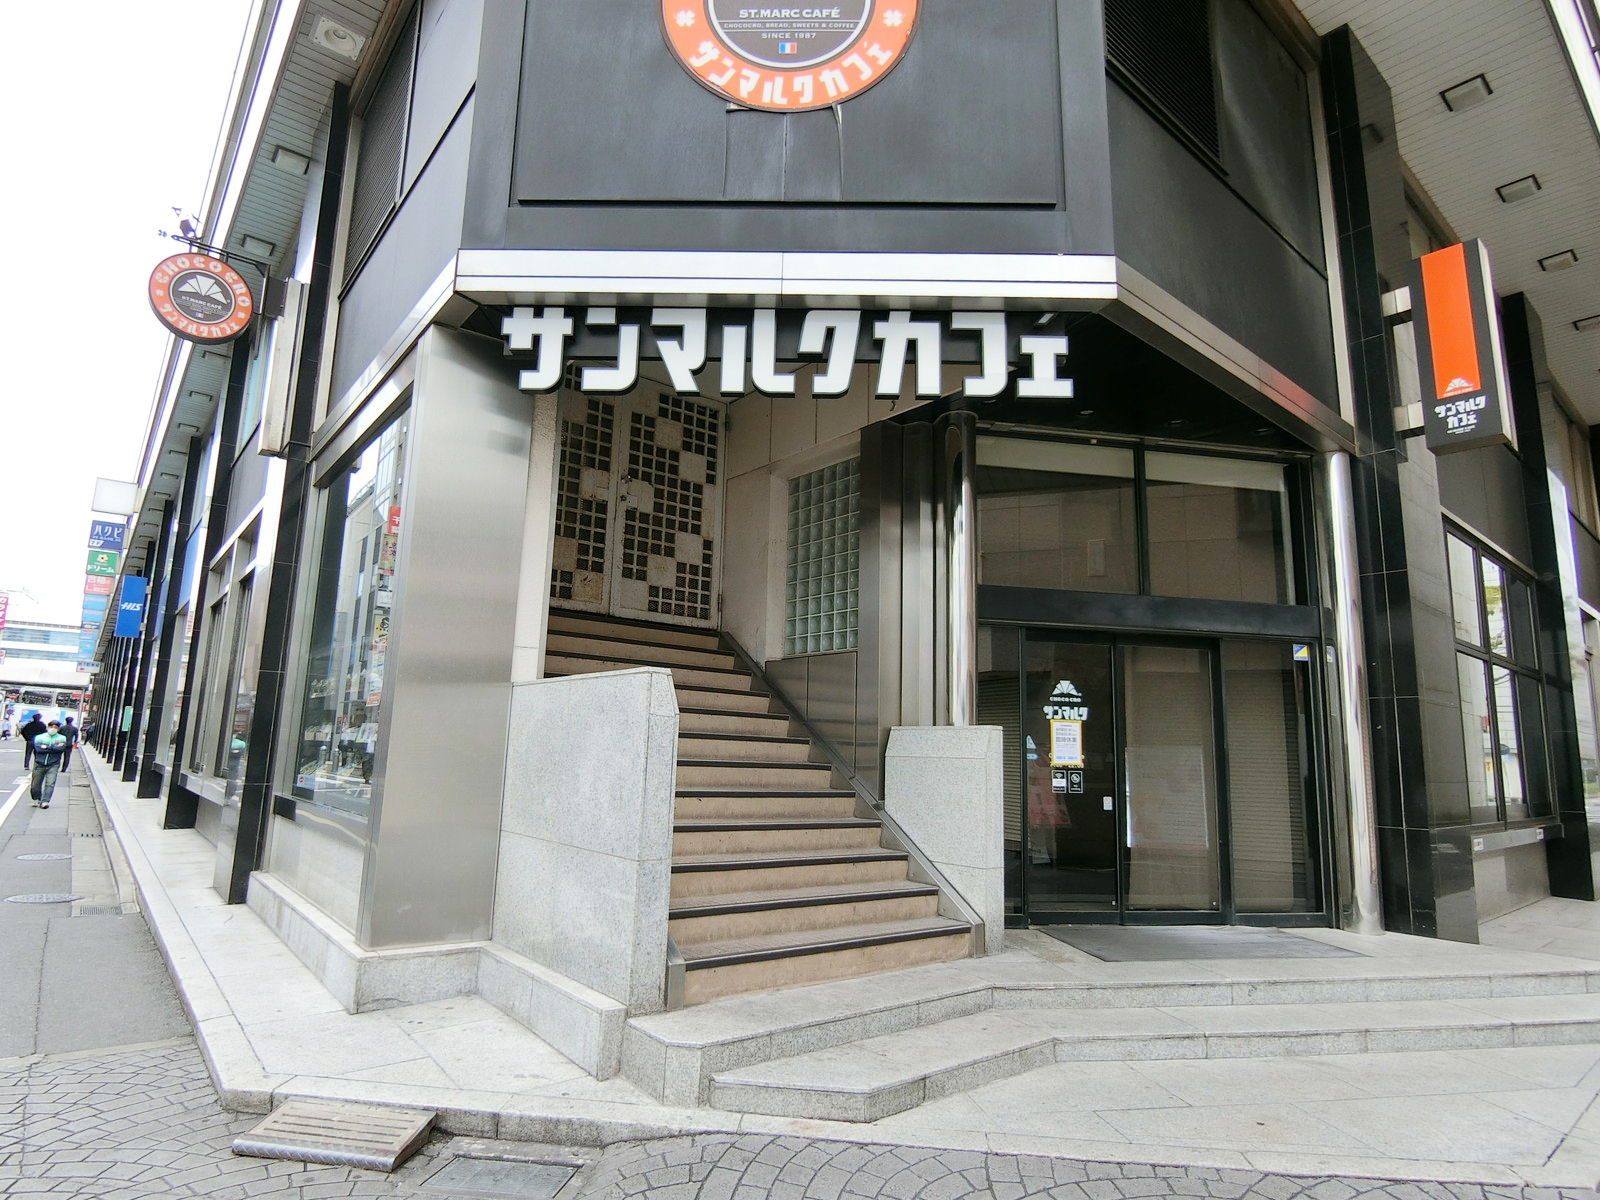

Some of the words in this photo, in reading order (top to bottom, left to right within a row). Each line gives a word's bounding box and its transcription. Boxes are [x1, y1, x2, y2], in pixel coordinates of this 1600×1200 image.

[739, 8, 800, 18] ST.MARC
[802, 7, 840, 18] CAFÉ
[689, 40, 893, 104] サンマルクカフェ
[501, 307, 1074, 399] サンマルクカフェ
[1434, 395, 1486, 418] サンマルク
[1447, 411, 1477, 428] カフェ
[93, 525, 123, 538] ハクビ
[87, 564, 114, 573] ドリーム
[1043, 705, 1089, 720] サンマルク
